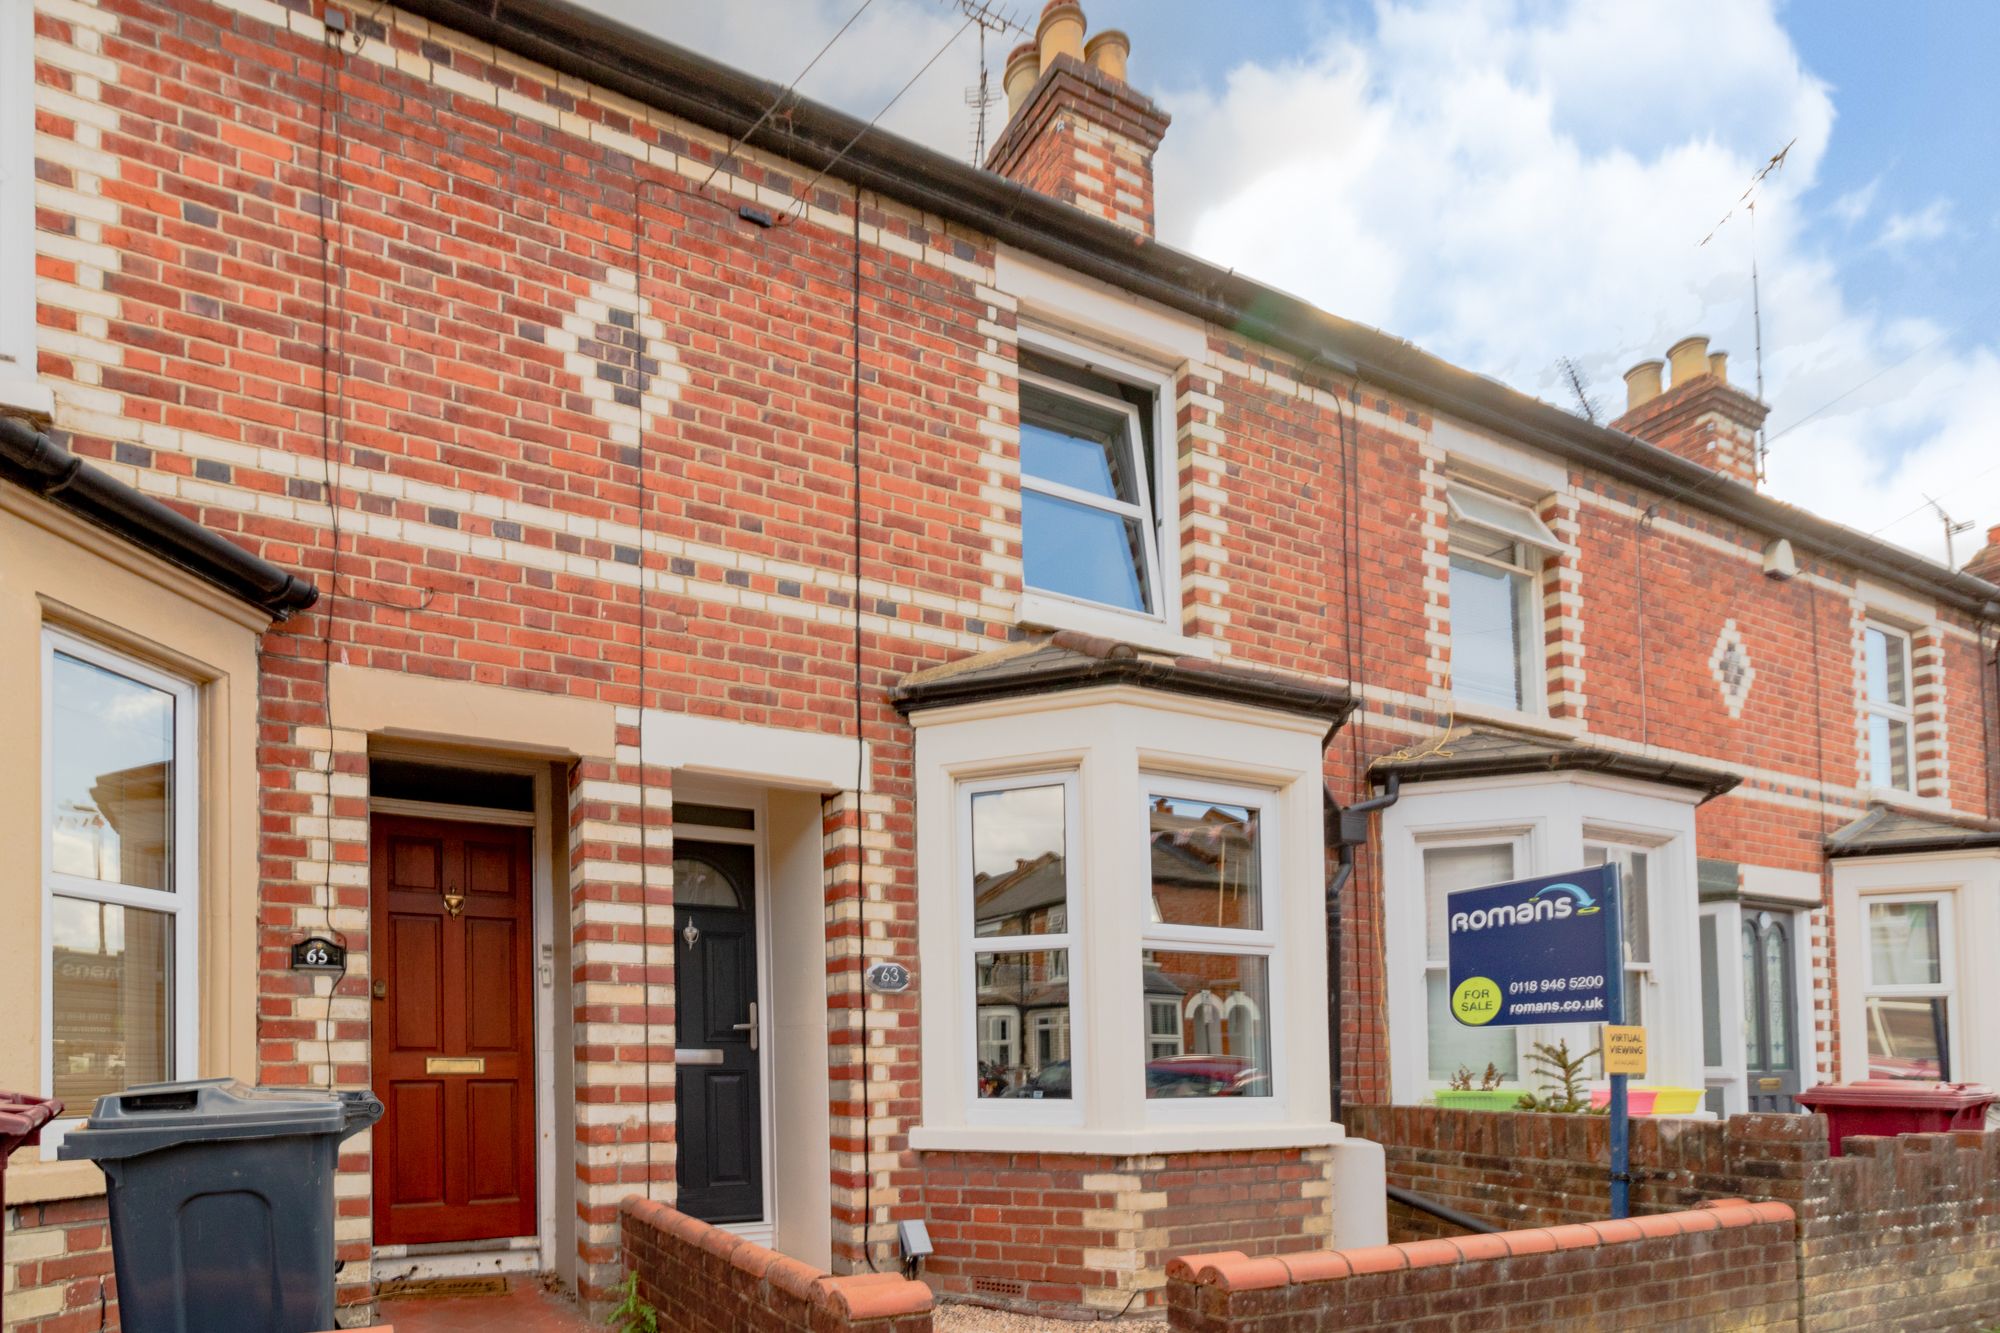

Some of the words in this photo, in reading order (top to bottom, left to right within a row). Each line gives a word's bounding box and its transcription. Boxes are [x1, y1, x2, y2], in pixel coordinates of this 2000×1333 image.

[306, 948, 328, 965] 65
[881, 967, 899, 981] 63
[1510, 980, 1538, 994] 0118
[1540, 978, 1566, 992] 946
[1569, 975, 1604, 990] 5200
[1464, 989, 1490, 1000] FOR
[1461, 1000, 1493, 1012] SALE
[1509, 996, 1604, 1014] romans.co.uk
[1610, 1033, 1643, 1043] VIRTUAL
[1609, 1045, 1644, 1055] VIEWING
